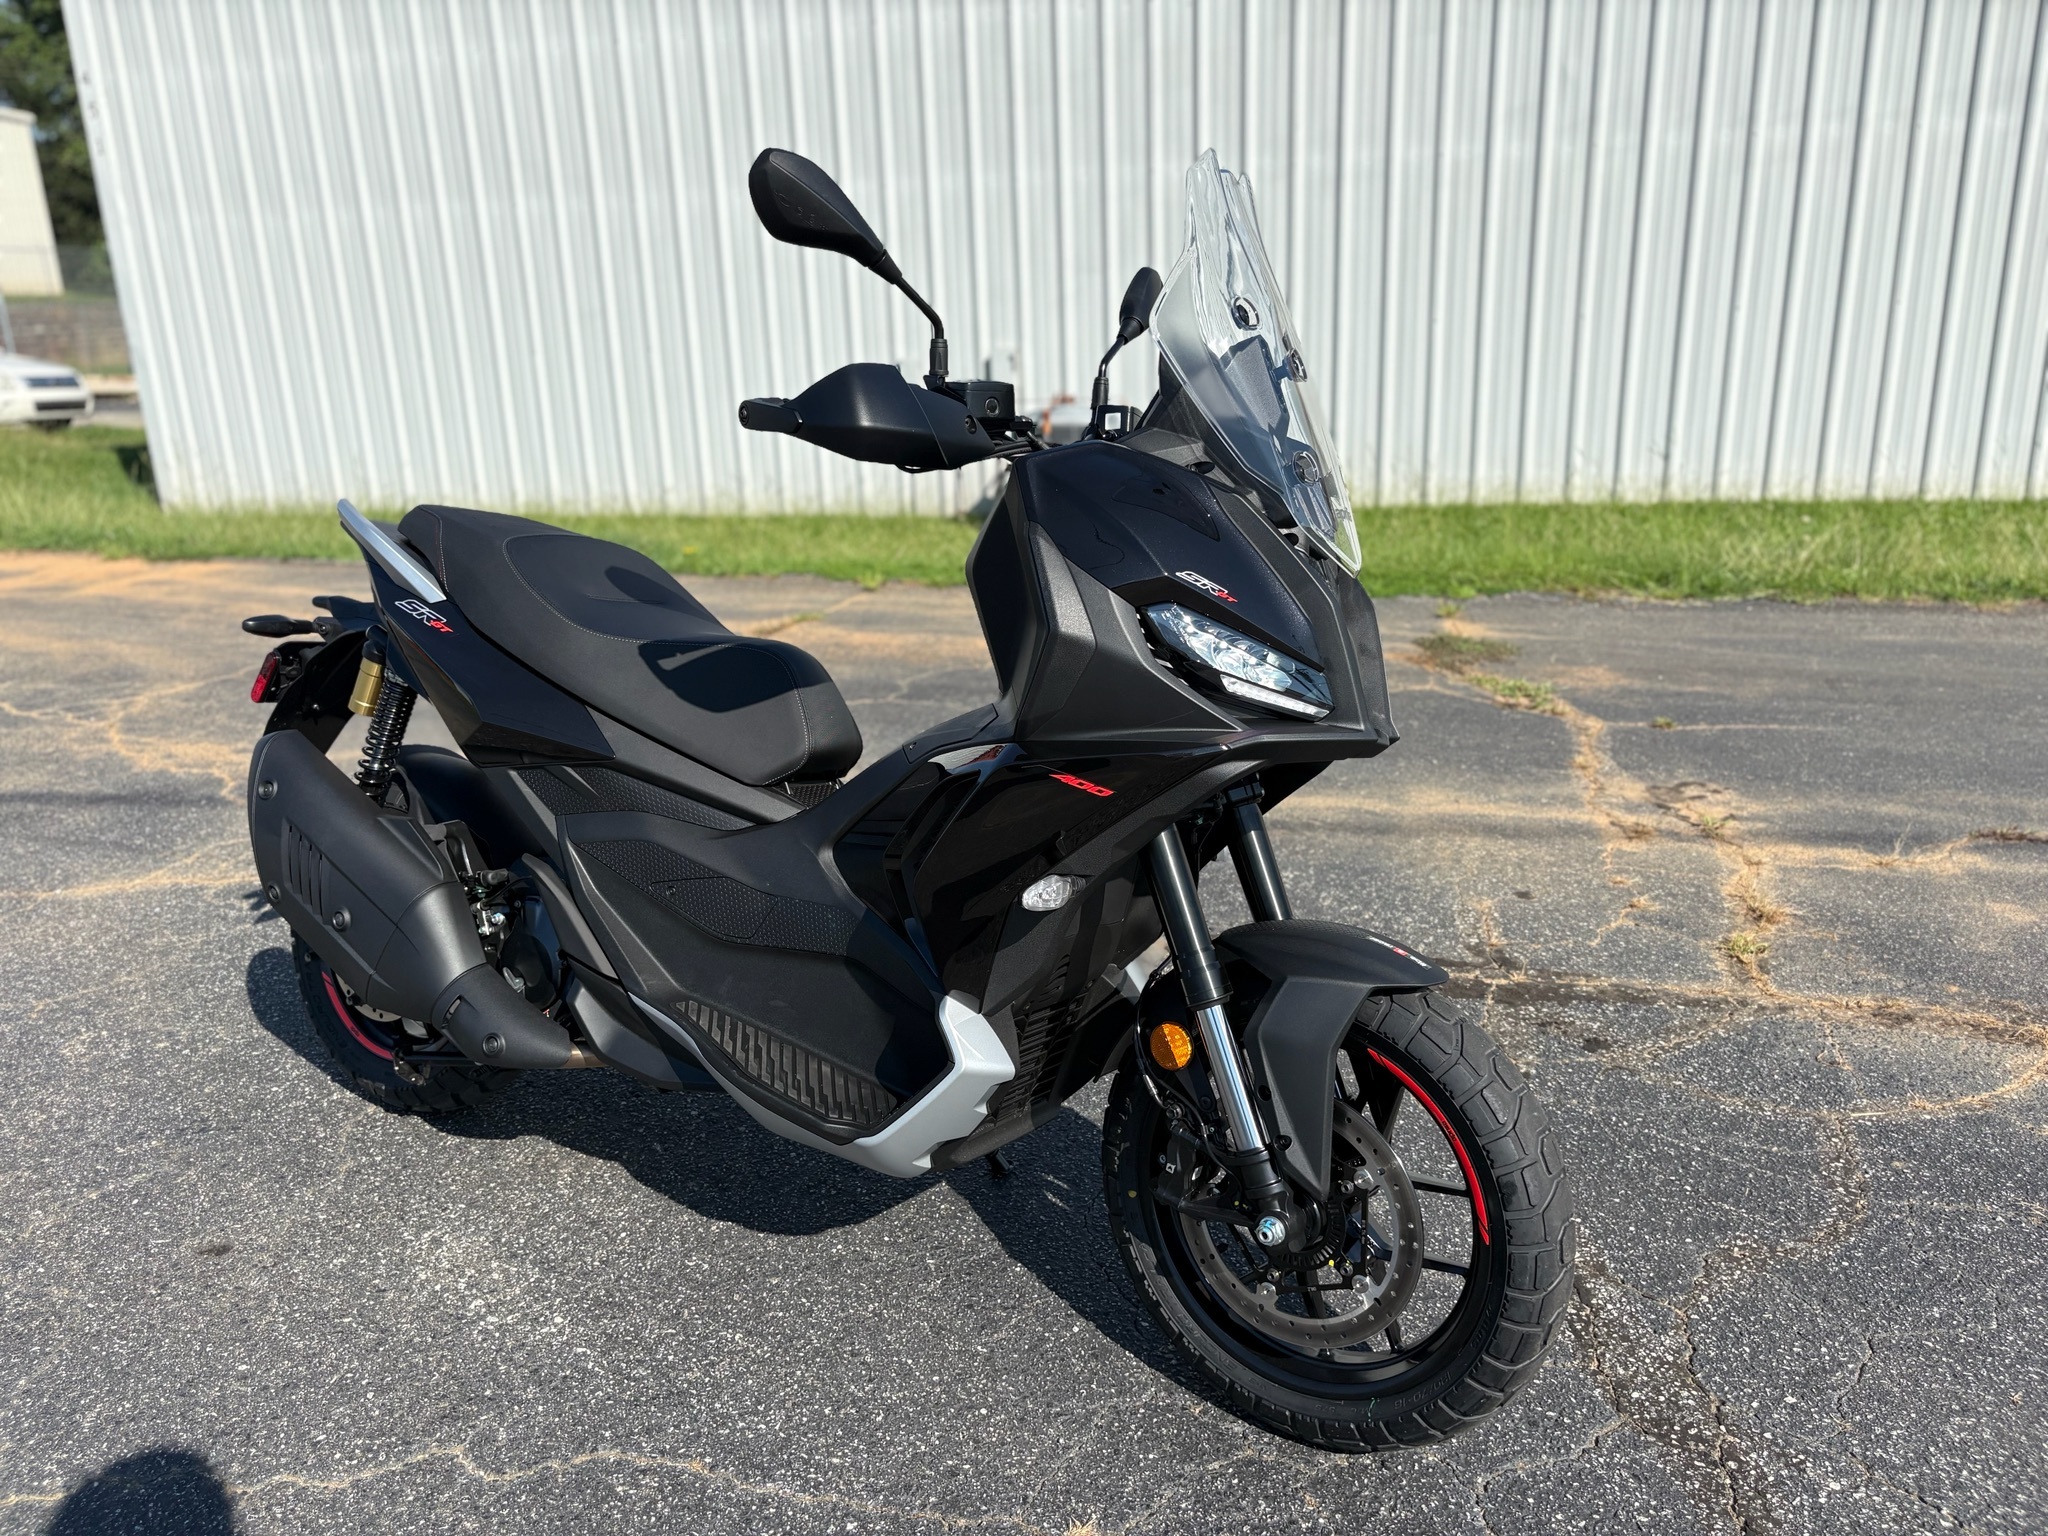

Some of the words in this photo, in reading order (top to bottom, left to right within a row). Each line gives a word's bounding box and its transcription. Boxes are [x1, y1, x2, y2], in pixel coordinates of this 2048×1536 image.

[1175, 571, 1229, 596] SR
[394, 599, 447, 627] SR
[1048, 774, 1115, 797] 400
